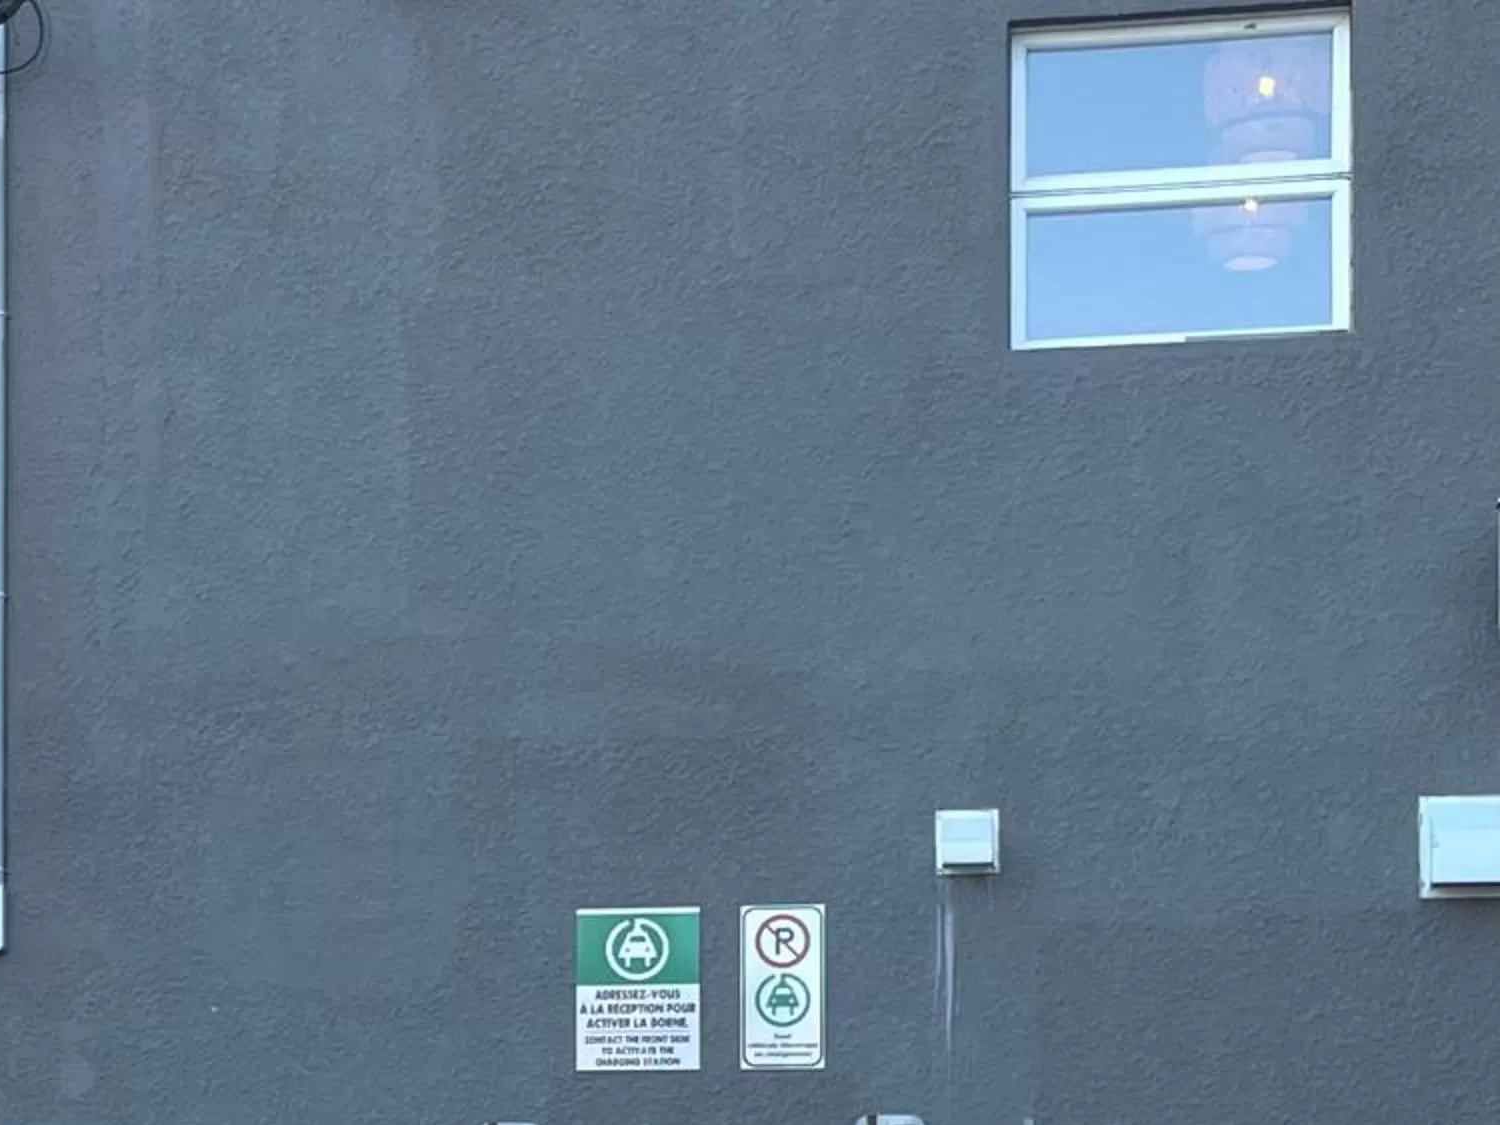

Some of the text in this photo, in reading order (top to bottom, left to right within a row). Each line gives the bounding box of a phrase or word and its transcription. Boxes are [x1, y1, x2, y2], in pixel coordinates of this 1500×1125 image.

[595, 988, 681, 1000] ADRESSEZ-VOUS
[591, 1003, 604, 1014] LA
[666, 1002, 696, 1013] POUR
[586, 1018, 630, 1028] ACTIVER
[634, 1018, 647, 1028] LA
